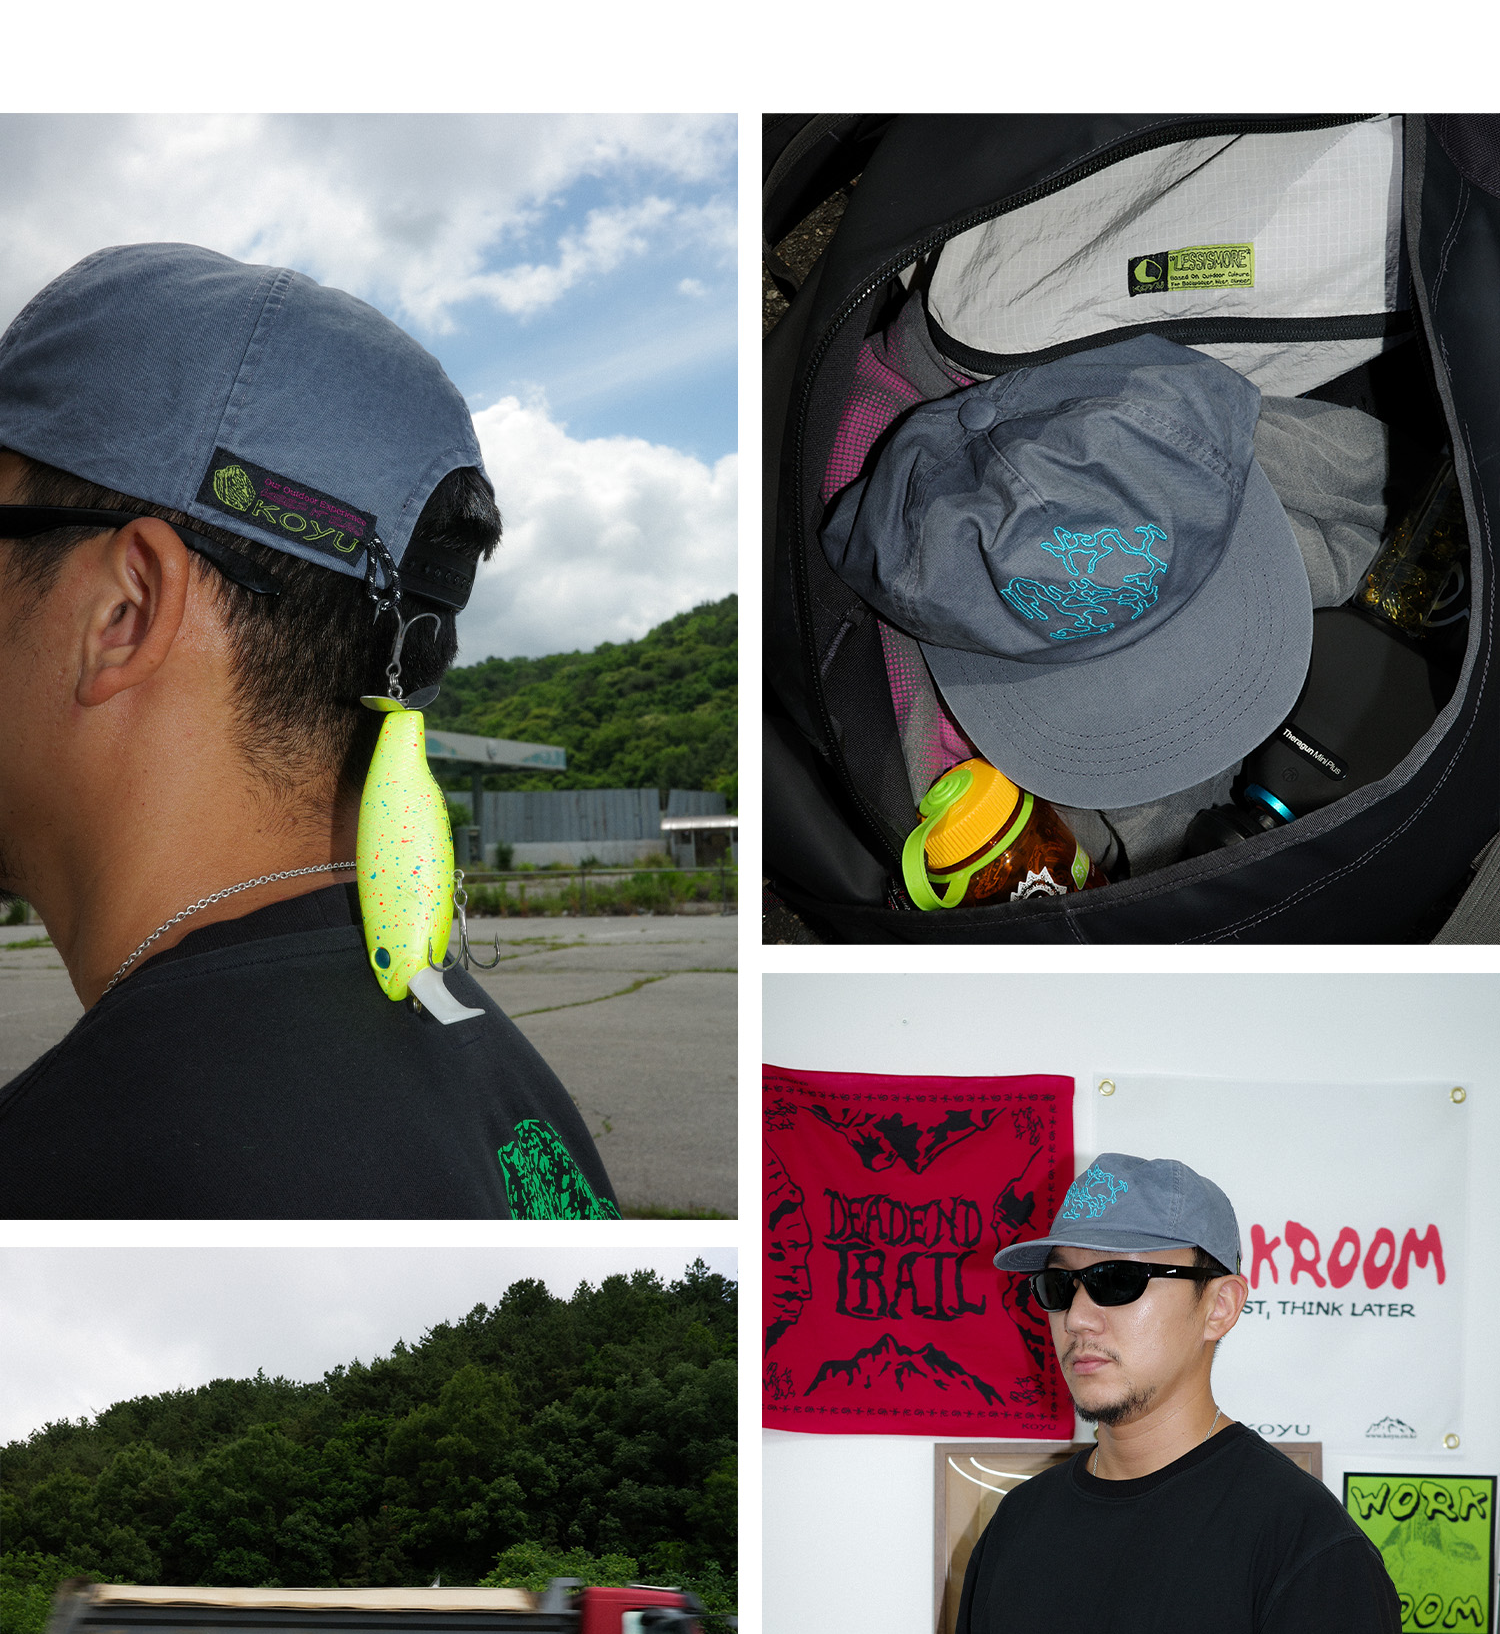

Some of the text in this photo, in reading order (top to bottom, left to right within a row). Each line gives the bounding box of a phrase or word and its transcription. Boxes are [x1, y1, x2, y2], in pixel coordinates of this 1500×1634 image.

[264, 478, 367, 526] Our Outdoor Experience
[252, 500, 359, 553] KOYU
[1282, 728, 1341, 775] Theragun Mini Plus
[823, 1188, 983, 1249] DEADEND
[1240, 1220, 1446, 1290] KROOM
[822, 1240, 987, 1322] TRAIL
[1278, 1301, 1344, 1316] THINK
[1351, 1303, 1416, 1317] LATER
[1022, 1422, 1056, 1431] KOYU
[1351, 1480, 1488, 1522] WORK
[1399, 1592, 1484, 1629] OOM
